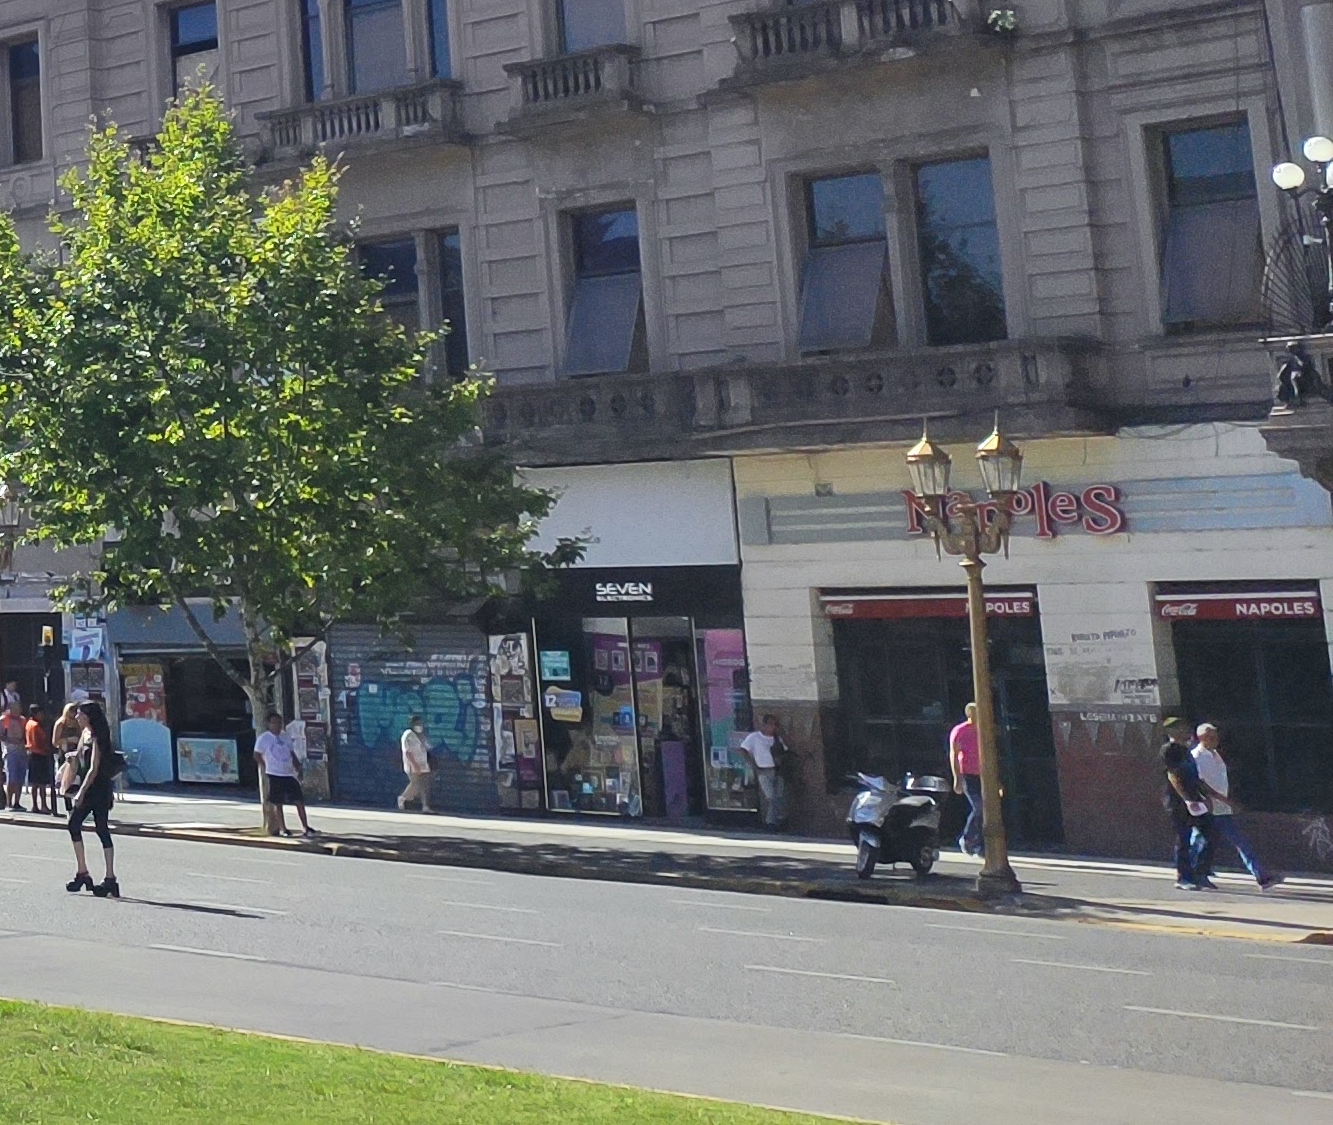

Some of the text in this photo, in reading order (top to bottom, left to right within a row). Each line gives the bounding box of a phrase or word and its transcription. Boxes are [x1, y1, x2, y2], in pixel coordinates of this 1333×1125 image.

[595, 582, 653, 595] SEVEN
[965, 601, 1030, 614] POLES
[1235, 602, 1315, 616] NAPOLES
